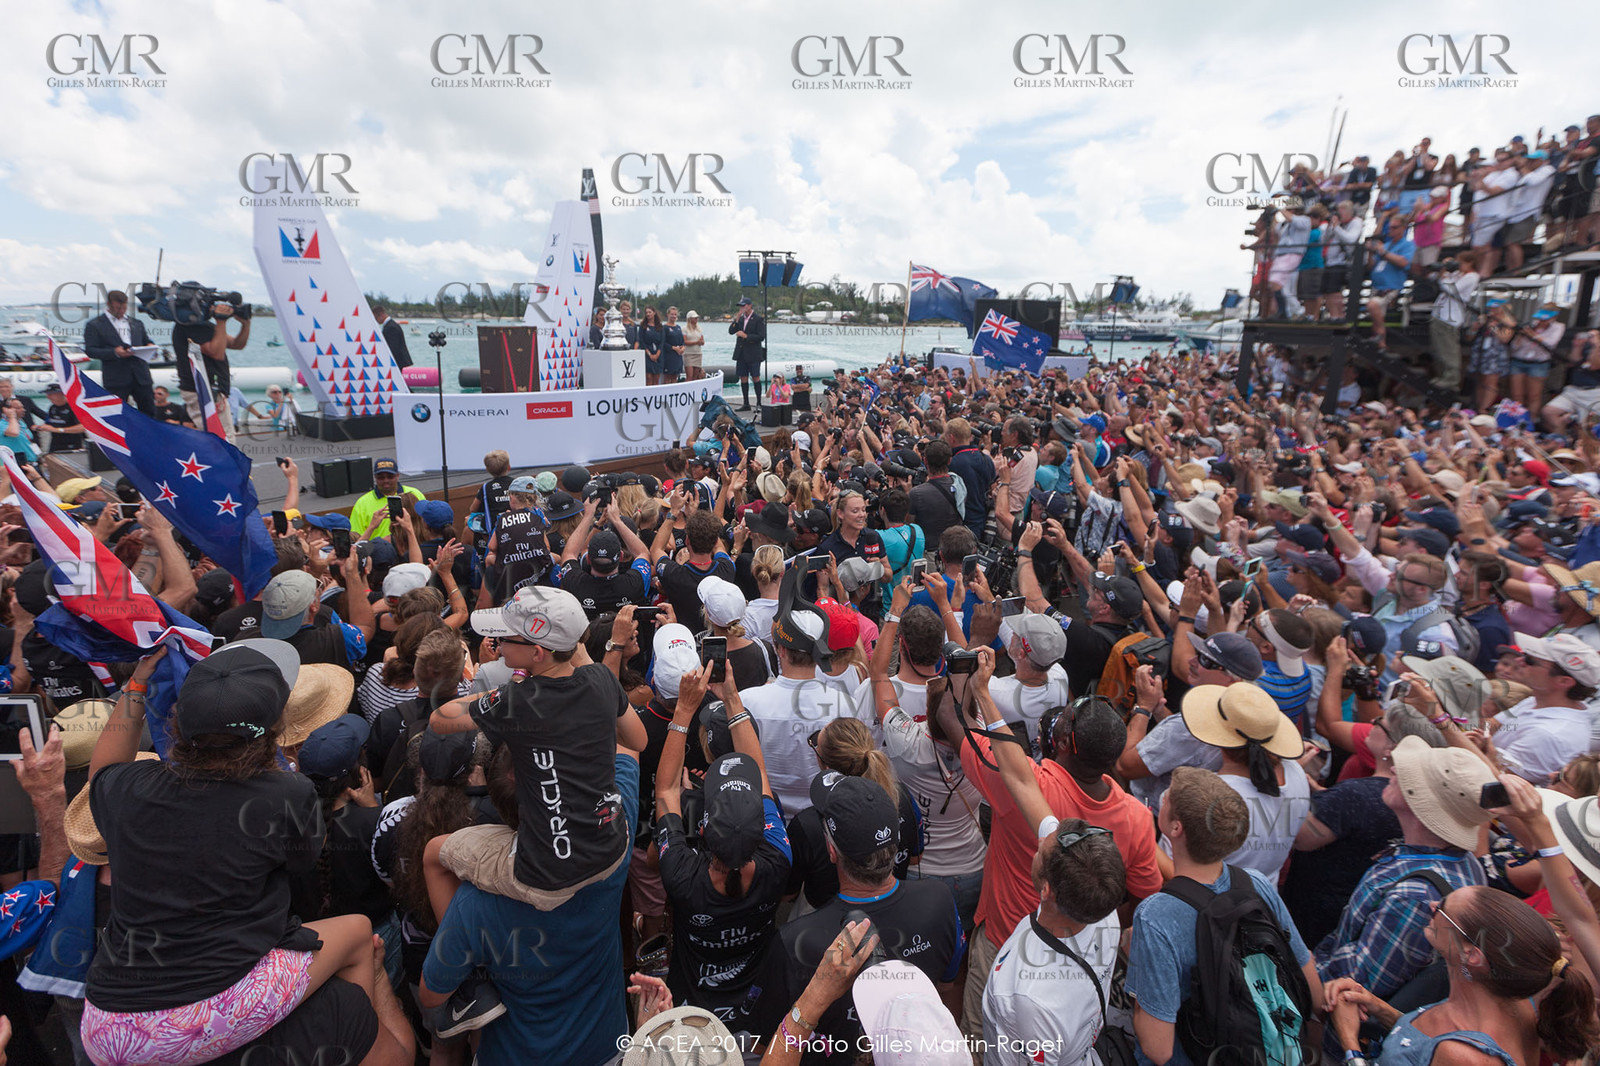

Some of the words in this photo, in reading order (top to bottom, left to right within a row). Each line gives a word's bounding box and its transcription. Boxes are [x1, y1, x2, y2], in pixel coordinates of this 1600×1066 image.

[532, 406, 567, 415] ORACLE
[587, 397, 639, 417] LOUIS
[643, 391, 696, 414] VUITTON
[449, 409, 509, 417] PANERAI
[501, 512, 531, 529] ASHBY
[516, 542, 530, 551] Fly
[504, 548, 544, 565] Emirates
[530, 617, 545, 634] 17
[532, 748, 571, 859] ORACLE
[903, 941, 932, 957] OMEGA
